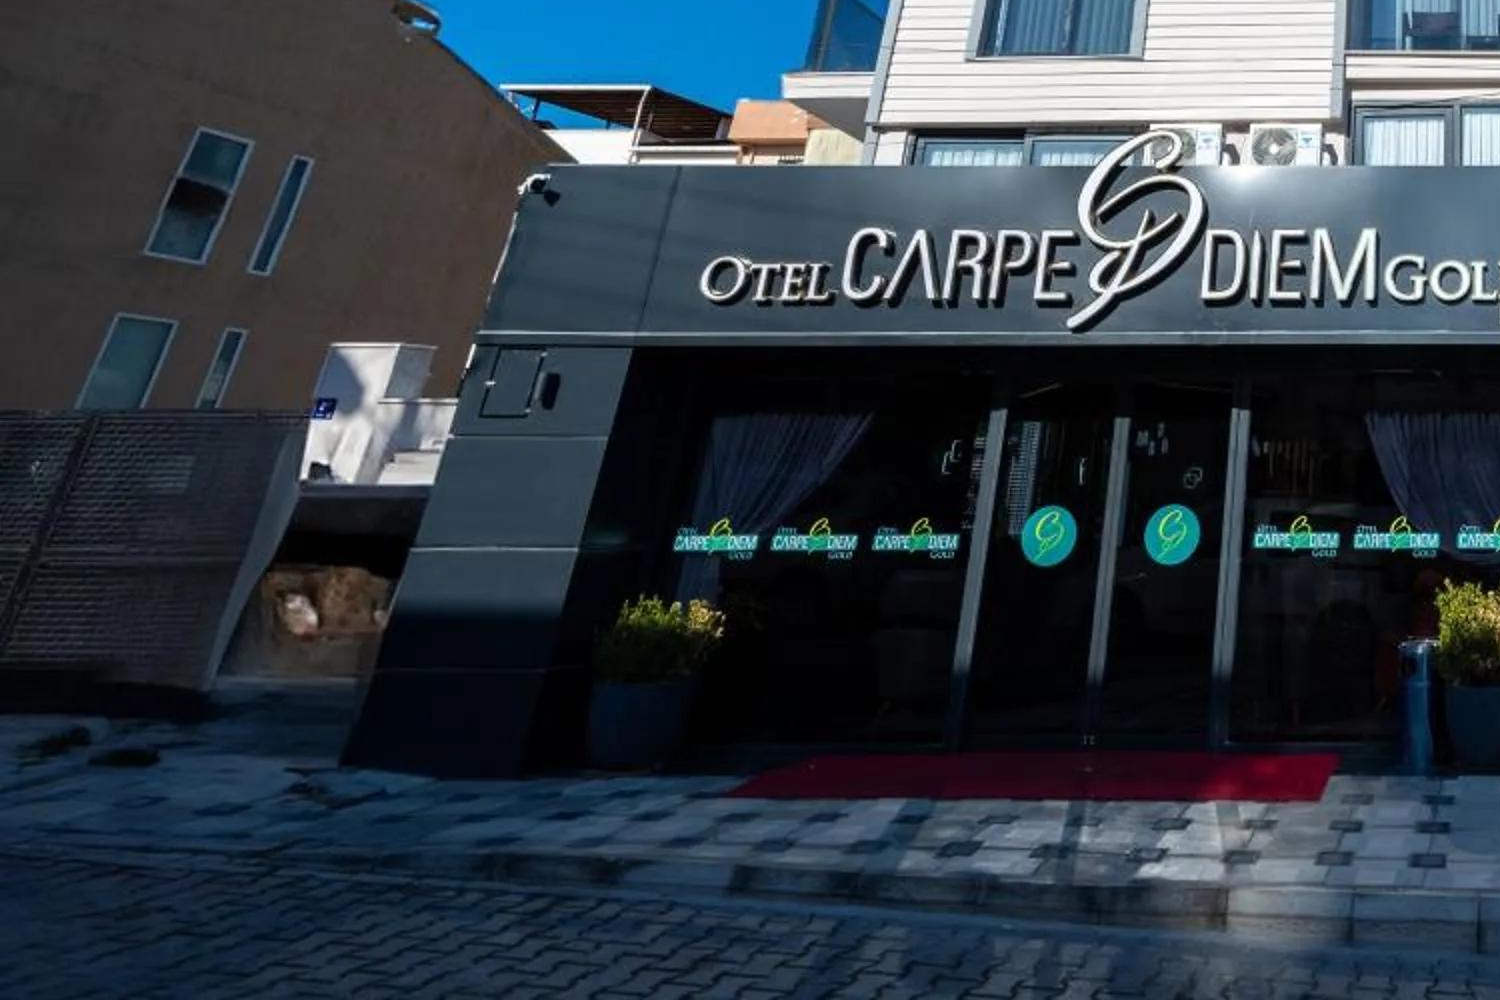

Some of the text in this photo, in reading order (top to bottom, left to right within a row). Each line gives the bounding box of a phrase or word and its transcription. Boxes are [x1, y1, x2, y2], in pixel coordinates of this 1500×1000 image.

[700, 256, 831, 300] OTEL
[842, 227, 1079, 301] CARPE
[1201, 227, 1378, 301] DIEM
